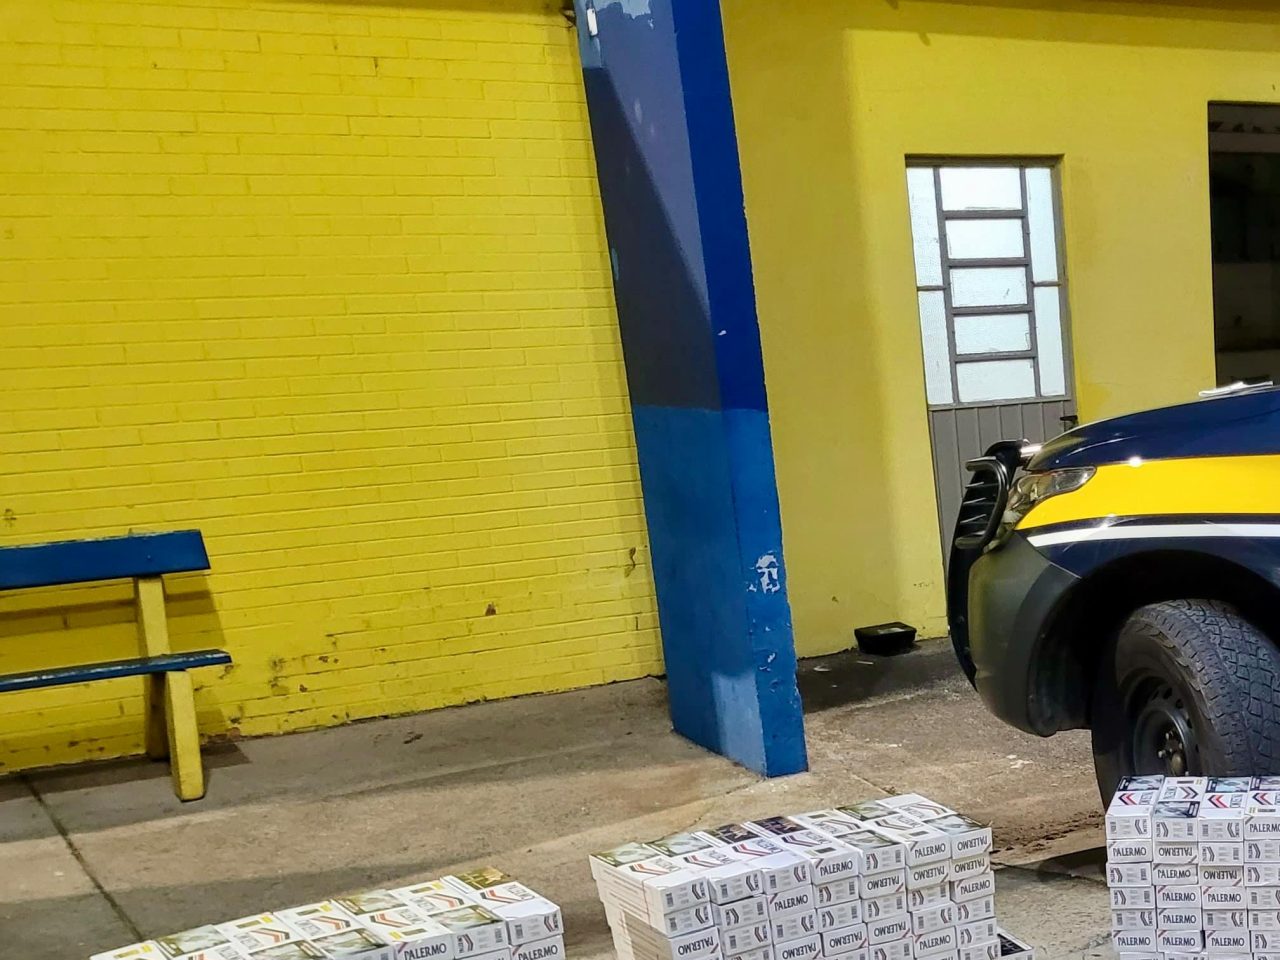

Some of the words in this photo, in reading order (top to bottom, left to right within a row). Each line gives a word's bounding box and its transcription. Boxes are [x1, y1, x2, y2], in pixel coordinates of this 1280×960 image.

[915, 843, 946, 858] PALERMO
[1158, 847, 1192, 856] PALERMO
[820, 860, 853, 876] PALERMO
[1158, 869, 1191, 878] PALERMO
[1203, 870, 1237, 879] PALERMO
[867, 876, 899, 890] PALERMO
[774, 894, 808, 911] PALERMO
[1162, 892, 1196, 901] PALERMO
[1163, 915, 1196, 924] PALERMO
[874, 921, 906, 937] PALERMO
[919, 934, 951, 950] PALERMO
[1118, 937, 1151, 946] PALERMO
[1162, 937, 1196, 946] PALERMO
[404, 943, 447, 960] PALERMO
[782, 942, 816, 960] PALERMO
